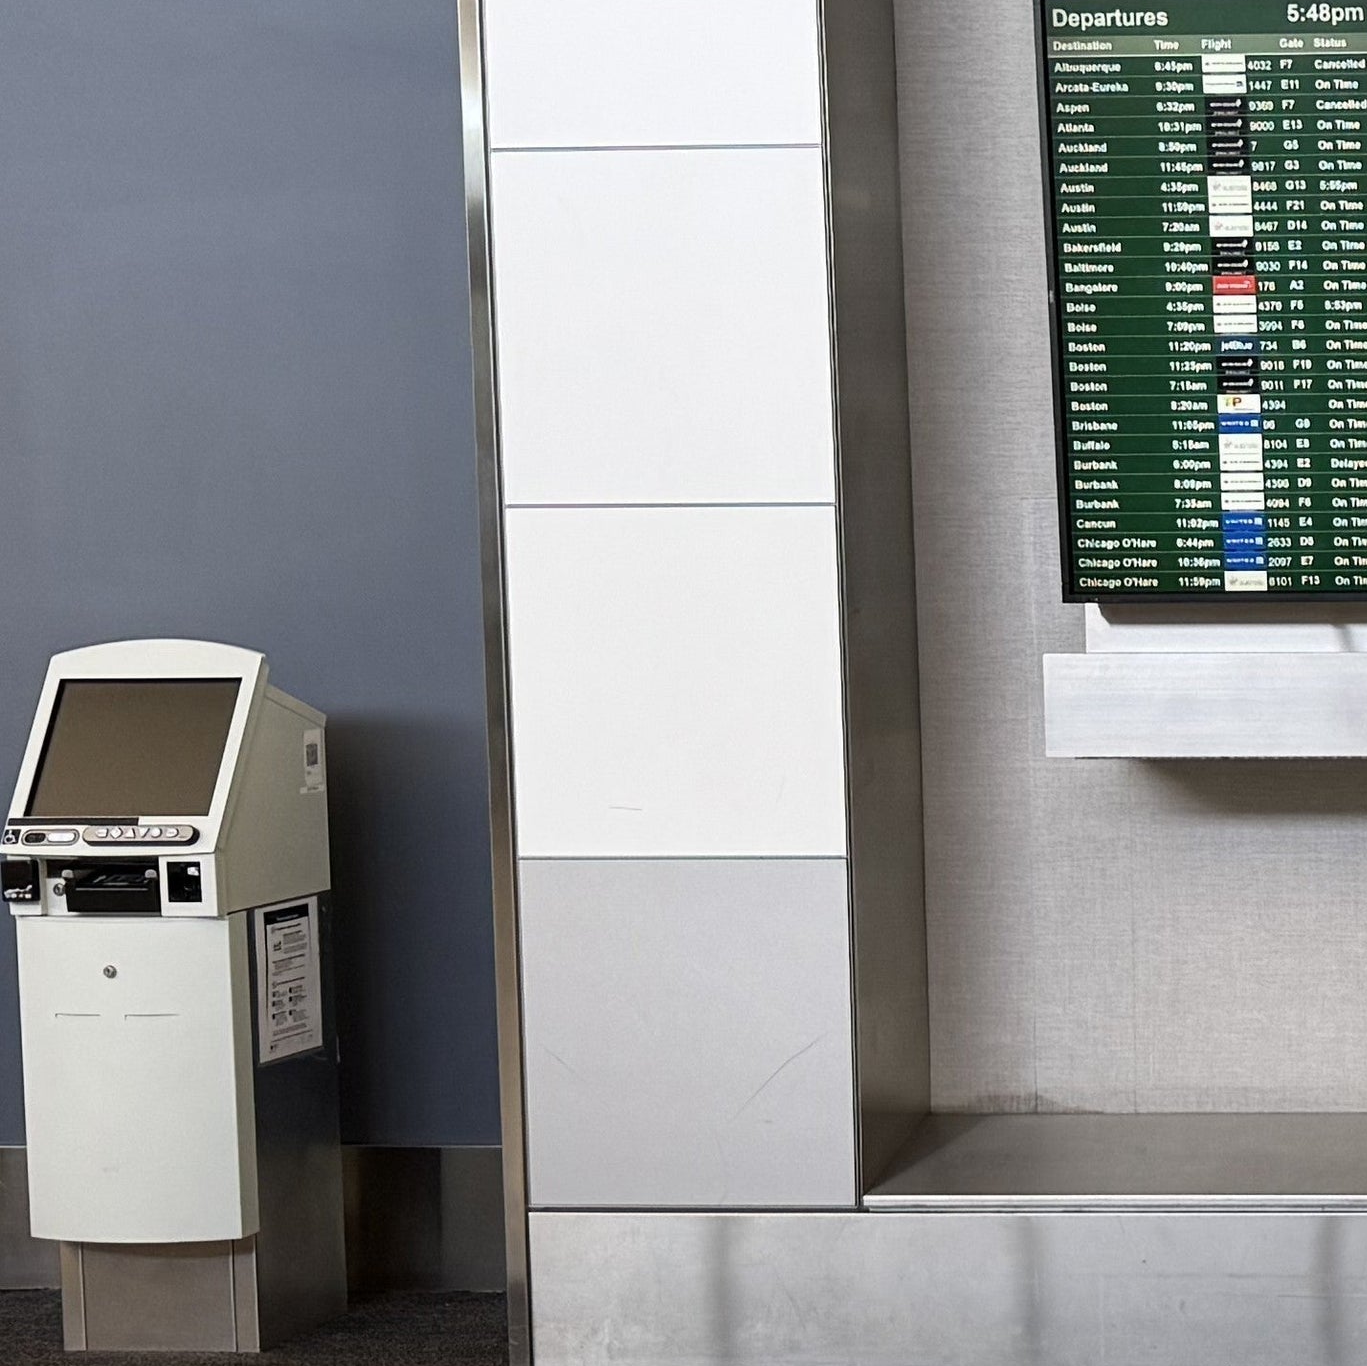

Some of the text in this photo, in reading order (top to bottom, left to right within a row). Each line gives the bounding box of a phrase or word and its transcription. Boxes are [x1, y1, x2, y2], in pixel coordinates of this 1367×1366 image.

[1052, 3, 1364, 30] Departures 5:48pm
[1053, 37, 1346, 51] Destination Time Flight Gate Status
[1056, 102, 1089, 114] Aspen
